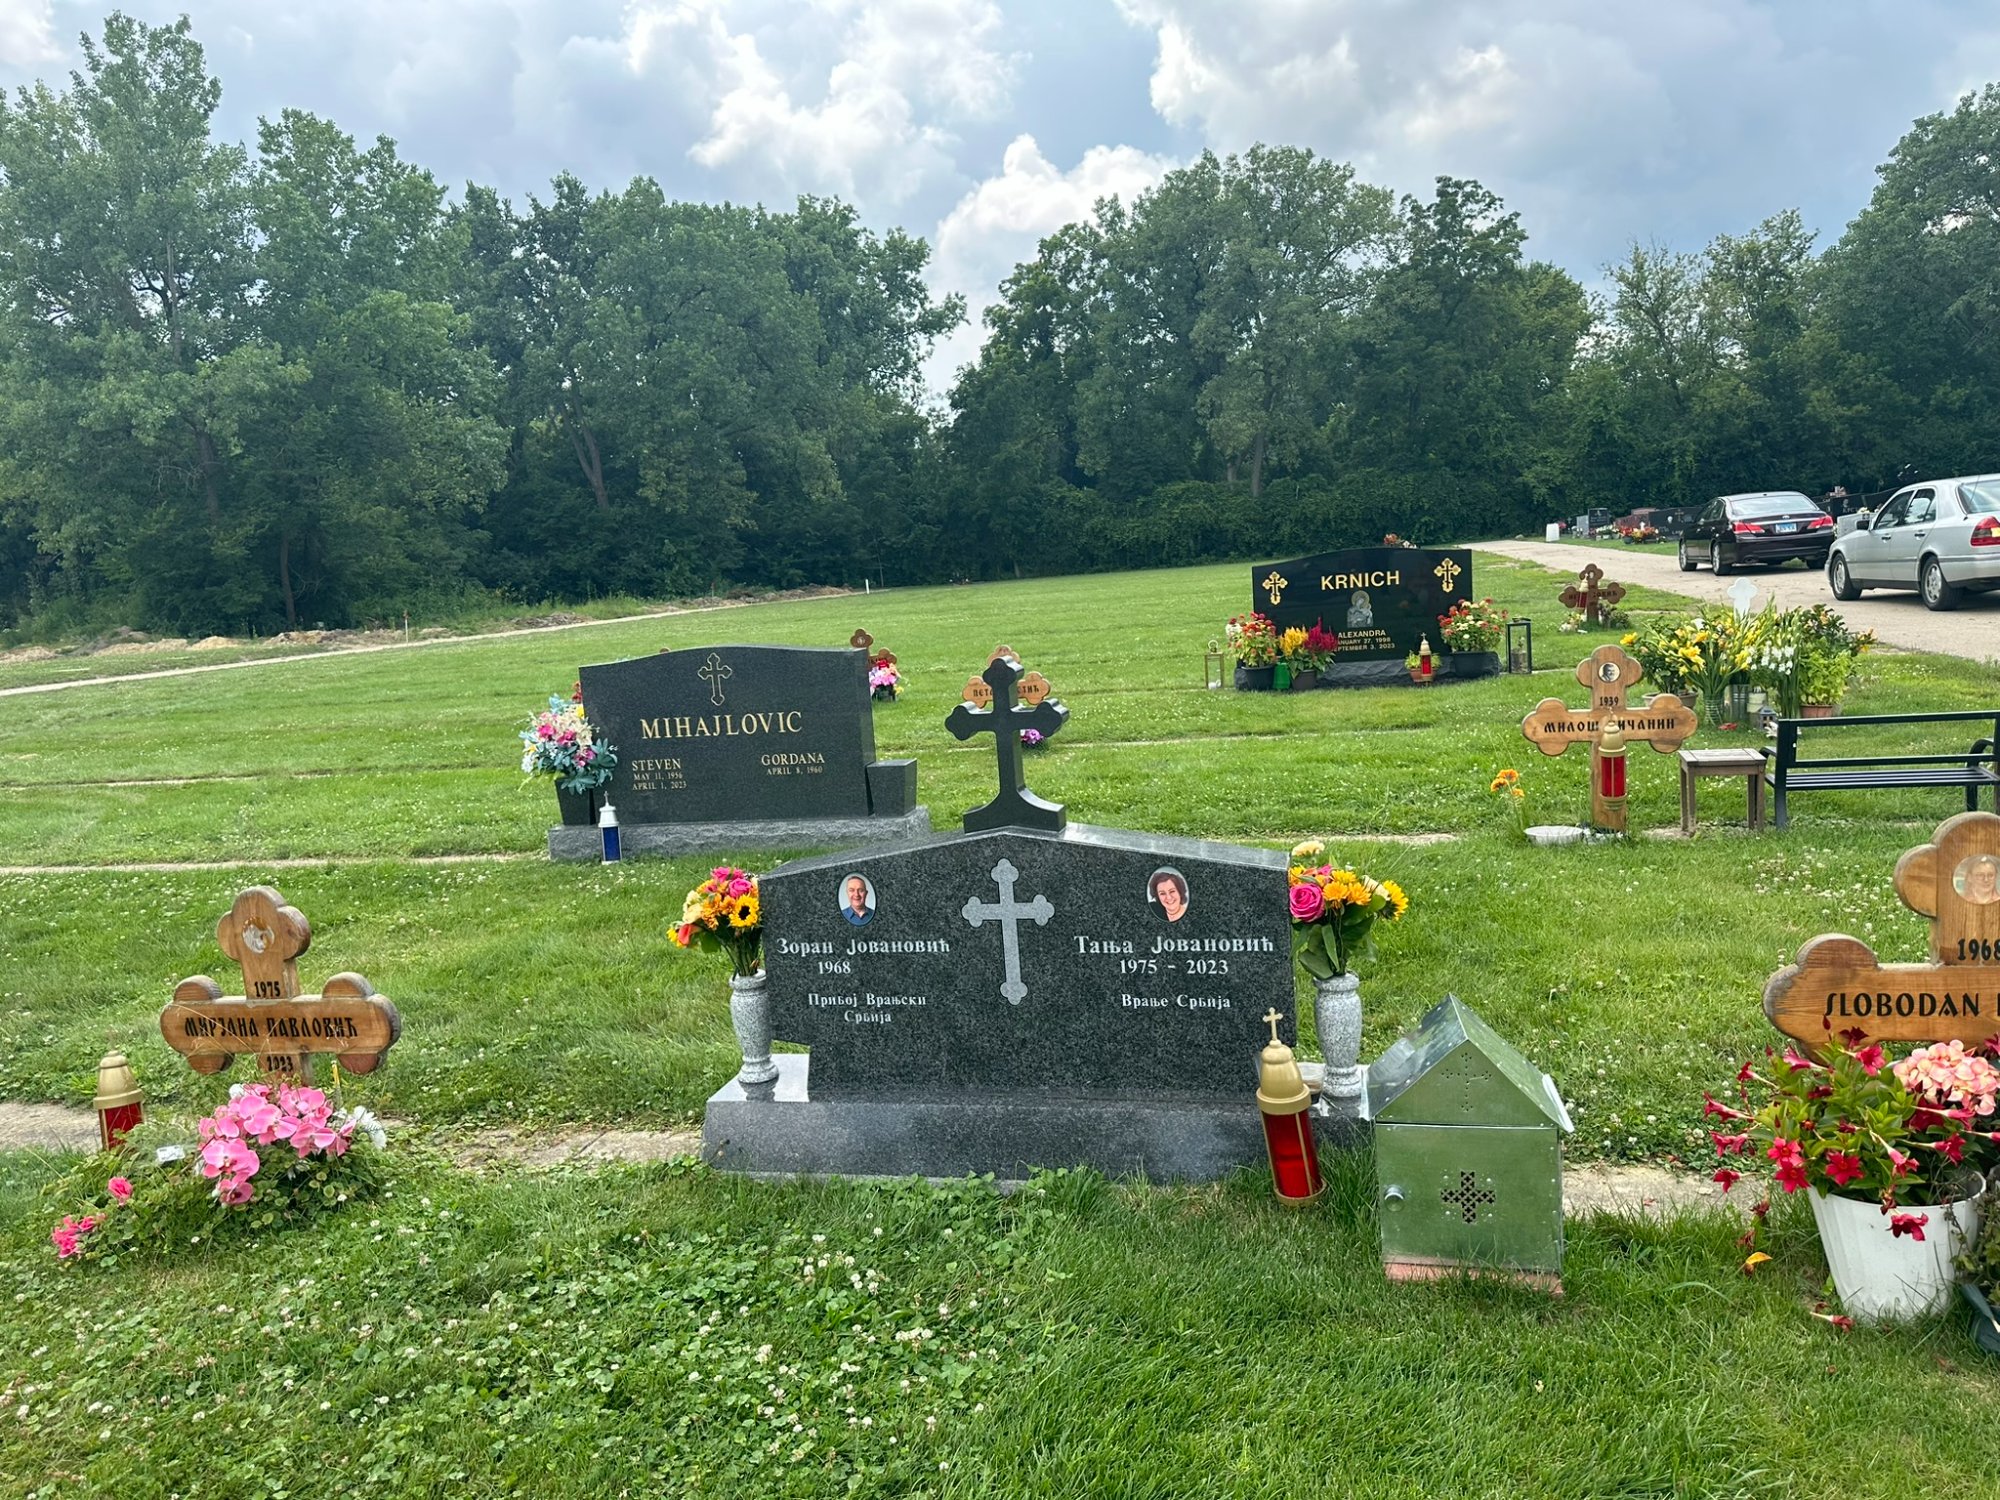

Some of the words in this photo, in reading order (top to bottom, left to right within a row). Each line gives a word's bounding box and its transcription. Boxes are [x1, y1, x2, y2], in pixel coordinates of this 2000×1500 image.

[1321, 570, 1400, 591] KRNICH
[1338, 630, 1386, 638] ALEXANDRA
[1599, 696, 1619, 706] 1939
[640, 711, 802, 739] MIHAJLOVIC
[631, 758, 681, 771] STEVEN
[761, 752, 825, 766] GORDANA
[633, 772, 650, 781] MAY
[668, 772, 683, 780] 1956
[767, 767, 792, 775] APRIL
[807, 766, 823, 774] 1960
[632, 782, 657, 790] APRIL
[671, 781, 687, 789] 2023
[776, 938, 834, 957] Зоран
[846, 938, 950, 956] Јовановић
[1074, 936, 1134, 954] Тања
[1151, 936, 1274, 954] Јовановић
[1958, 938, 2000, 960] 1968
[818, 960, 851, 974] 1968
[1120, 960, 1158, 974] 1975
[1187, 960, 1228, 974] 2023
[254, 981, 280, 998] 1975
[808, 993, 858, 1008] Прибој
[866, 993, 926, 1008] Врањски
[1122, 994, 1169, 1008] Врање
[1177, 994, 1231, 1010] Србија
[1825, 992, 1980, 1017] SLOBODAN
[844, 1010, 892, 1024] Србија
[267, 1016, 358, 1038] ПАВЛОВИЋ
